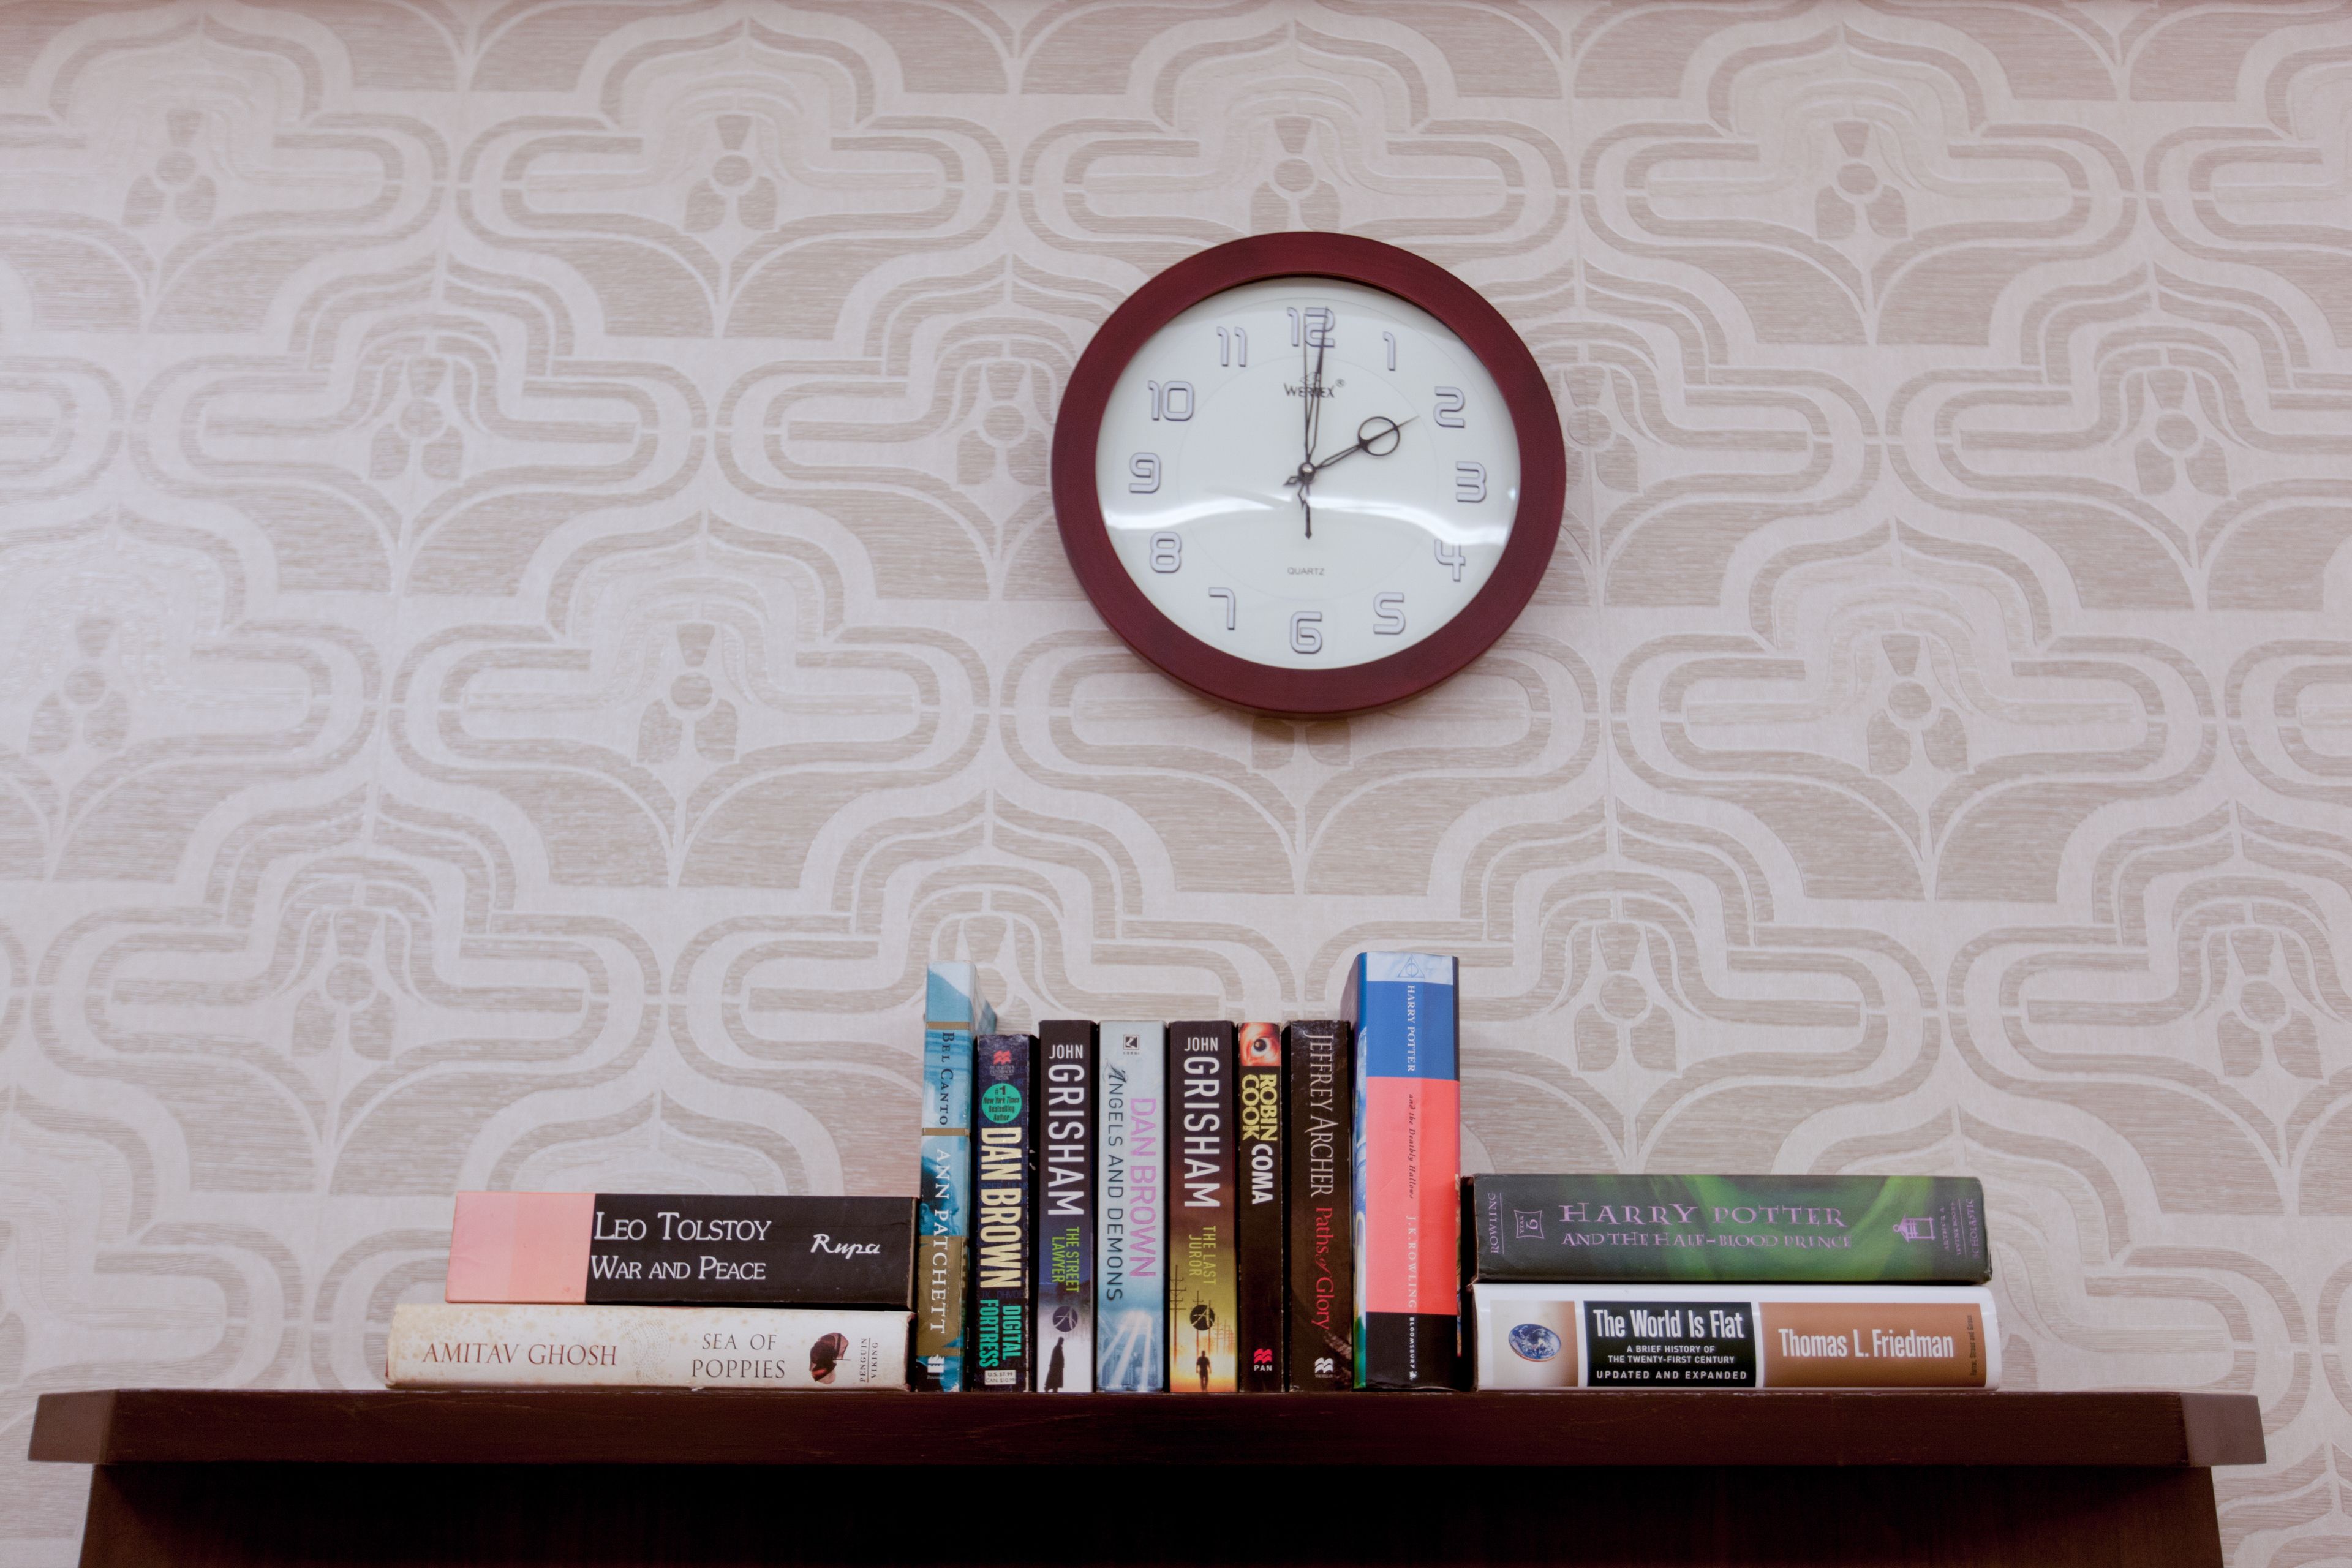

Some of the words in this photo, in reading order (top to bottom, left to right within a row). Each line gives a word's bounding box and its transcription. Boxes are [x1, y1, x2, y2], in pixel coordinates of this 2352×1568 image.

[1217, 326, 1246, 367] 11
[1287, 307, 1335, 348] 12
[1382, 331, 1396, 371] 1
[1148, 381, 1194, 421] 10
[1433, 386, 1464, 428] 2
[1129, 453, 1161, 493] 9
[1455, 461, 1487, 503] 3
[1149, 532, 1182, 573] 8
[1287, 567, 1325, 576] QUARTZ
[1434, 538, 1466, 582] 4
[1208, 587, 1235, 630] 7
[1373, 592, 1406, 635] 5
[1290, 611, 1322, 654] 6
[941, 1032, 955, 1063] BEL
[1049, 1044, 1084, 1059] JOHN
[1184, 1037, 1218, 1052] JOHN
[995, 1085, 1006, 1095] #1
[1303, 1031, 1334, 1112] JEFFREY
[940, 1068, 954, 1125] CANTO
[1107, 1063, 1127, 1147] ANGELS
[1242, 1074, 1260, 1140] COOK
[1259, 1074, 1278, 1142] ROBIN
[1048, 1064, 1084, 1215] GRISHAM
[1130, 1098, 1156, 1156] DAN
[1183, 1057, 1221, 1207] GRISHAM
[1408, 1128, 1417, 1161] Deathly
[935, 1149, 951, 1199] ANN
[981, 1127, 1022, 1180] DAN
[1251, 1144, 1273, 1205] COMA
[1305, 1115, 1339, 1199] ARCHER
[1107, 1154, 1123, 1199] AND
[594, 1211, 647, 1241] LEO
[657, 1211, 772, 1241] TOLSTOY
[1130, 1166, 1156, 1277] BROWN
[1316, 1208, 1333, 1253] Paths
[1488, 1193, 1499, 1254] ROWLING
[1526, 1219, 1538, 1230] 6
[1558, 1202, 1698, 1225] HARRY
[1713, 1205, 1848, 1227] POTTER
[1966, 1198, 1980, 1259] SCHOLASTIC
[810, 1233, 881, 1259] Rupa
[980, 1188, 1022, 1288] BROWN
[1066, 1226, 1080, 1247] THE
[1107, 1208, 1123, 1301] DEMONS
[1189, 1234, 1202, 1276] JUROR
[1202, 1226, 1216, 1248] THE
[1561, 1232, 1604, 1246] AND
[1607, 1231, 1648, 1246] THE
[1652, 1233, 1779, 1248] HALF-BLOOD
[1783, 1235, 1852, 1250] PRINCE
[590, 1255, 642, 1280] WAR
[649, 1262, 691, 1280] AND
[699, 1256, 766, 1280] PEACE
[930, 1209, 949, 1334] PATCHETT
[1052, 1237, 1065, 1283] LAWYER
[1066, 1251, 1080, 1292] STREET
[1202, 1251, 1216, 1286] LAST
[1314, 1254, 1332, 1278] of
[1311, 1276, 1334, 1330] Glory
[1593, 1310, 1625, 1338] The
[1630, 1310, 1681, 1338] World
[1688, 1310, 1705, 1338] Is
[1709, 1310, 1744, 1338] Flat
[702, 1333, 738, 1350] SEA
[750, 1333, 777, 1350] OF
[979, 1299, 1000, 1368] FORTRESS
[1002, 1305, 1022, 1360] DIGITAL
[1778, 1328, 1848, 1357] Thomas
[1853, 1329, 1869, 1357] L.
[1872, 1329, 1954, 1358] Friedman
[423, 1343, 519, 1363] AMITAV
[528, 1344, 617, 1366] GHOSH
[692, 1359, 785, 1379] POPPIES
[1596, 1370, 1650, 1379] UPDATED
